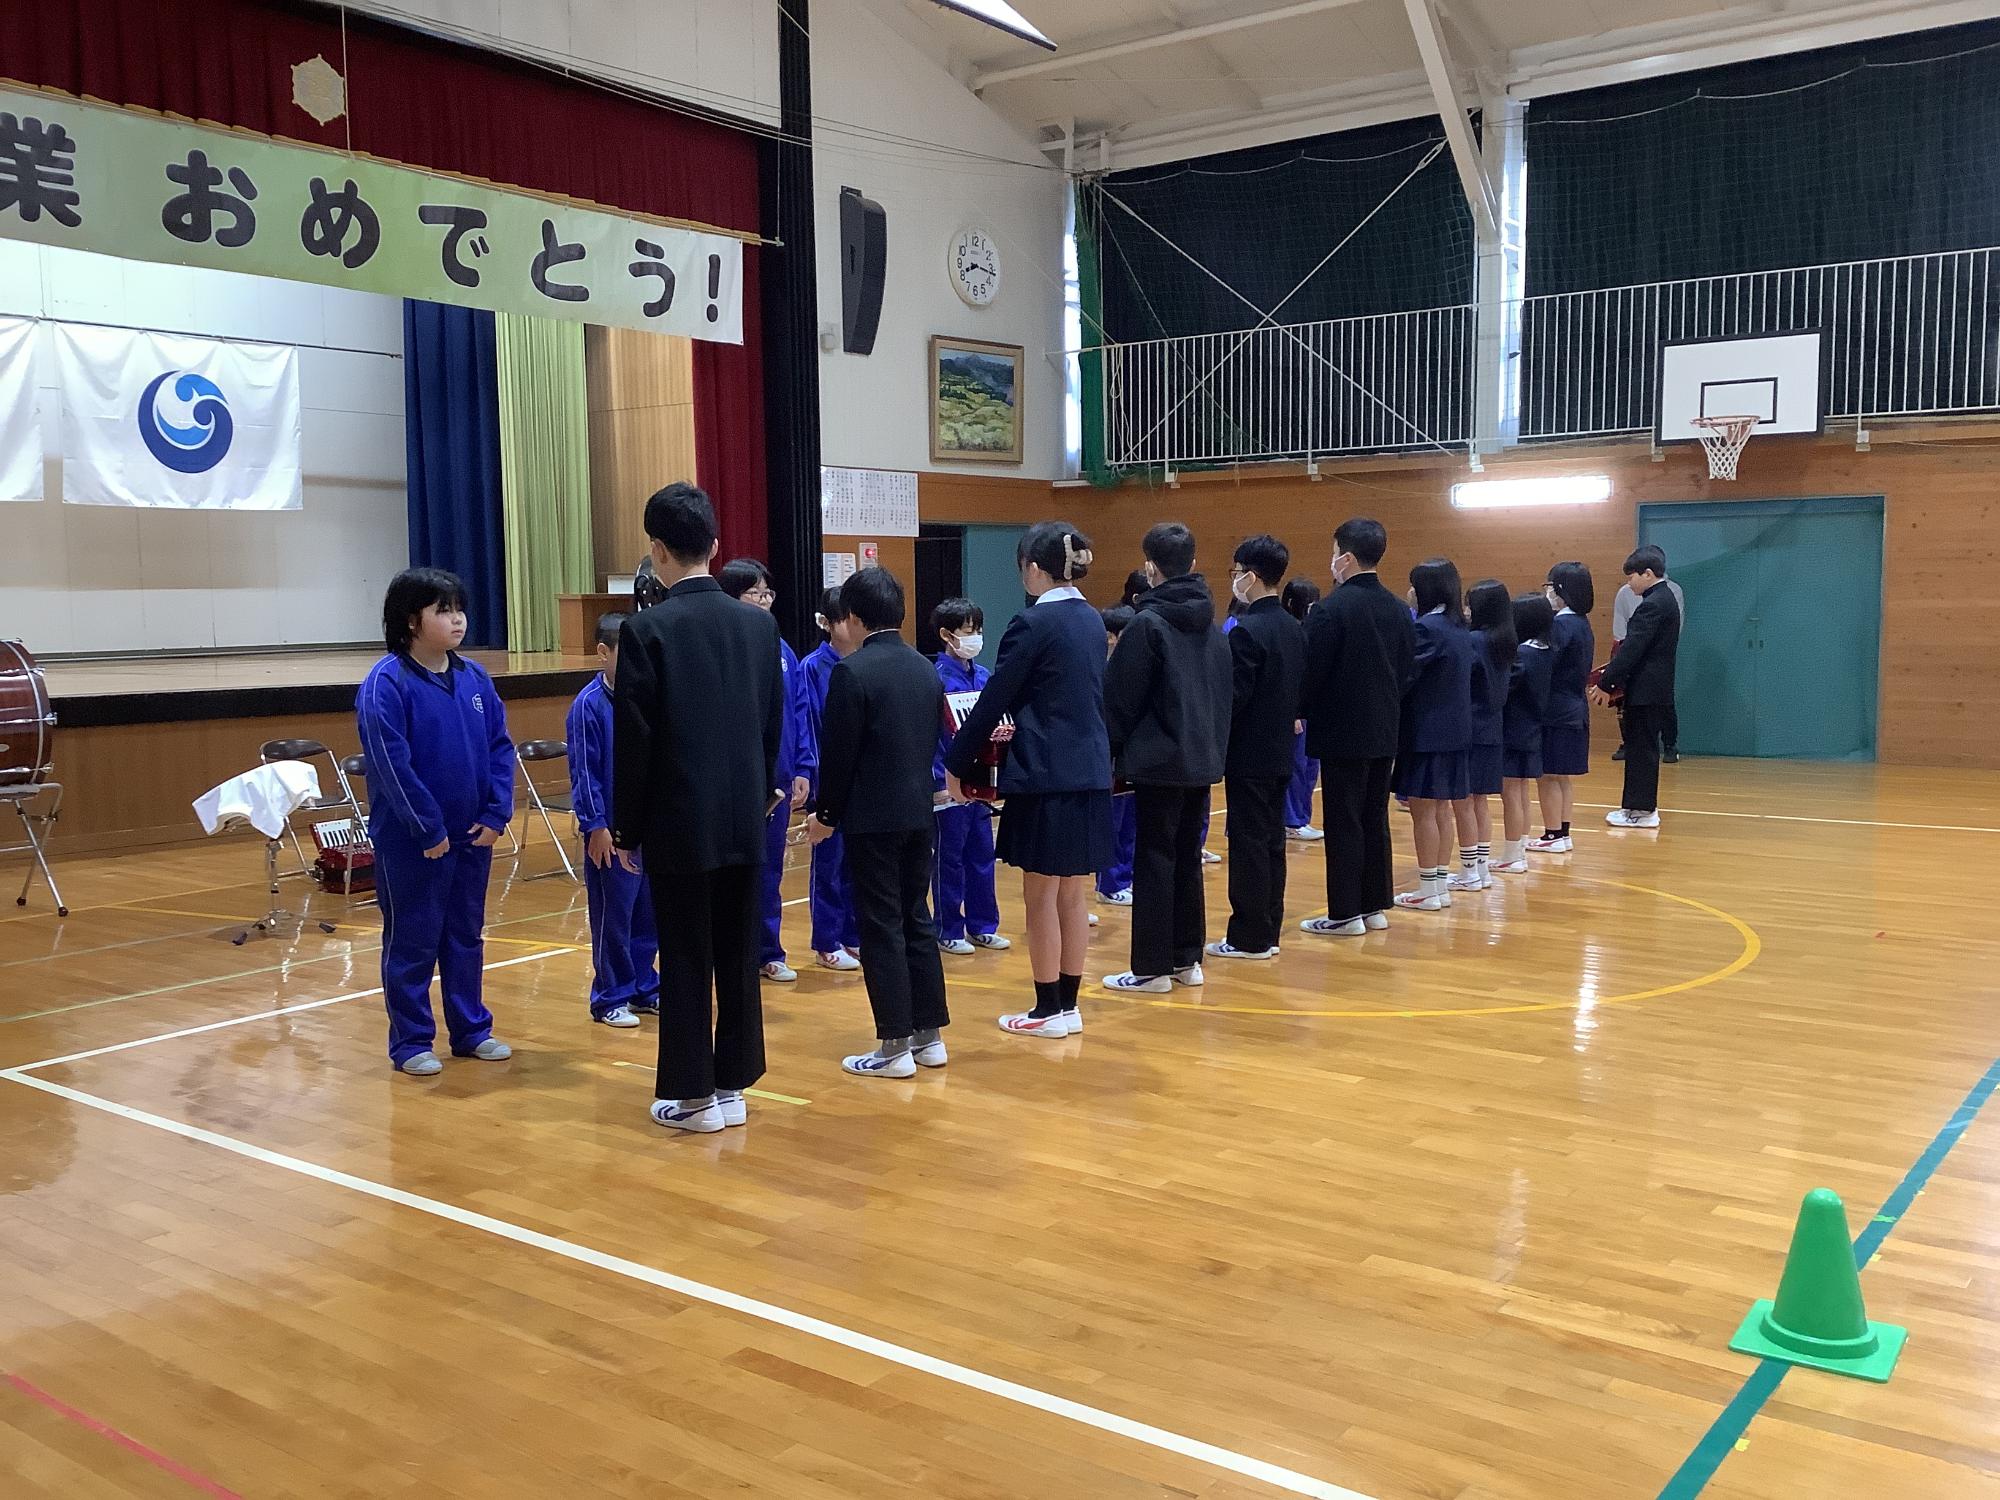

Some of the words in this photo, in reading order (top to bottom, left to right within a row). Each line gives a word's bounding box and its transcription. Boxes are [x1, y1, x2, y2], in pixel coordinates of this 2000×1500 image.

[971, 235, 979, 247] 12
[959, 245, 966, 257] 10
[985, 250, 992, 261] 2
[957, 257, 963, 269] 9
[960, 269, 966, 281] 8
[966, 281, 971, 292] 7
[972, 285, 979, 297] 6
[980, 283, 986, 294] 5
